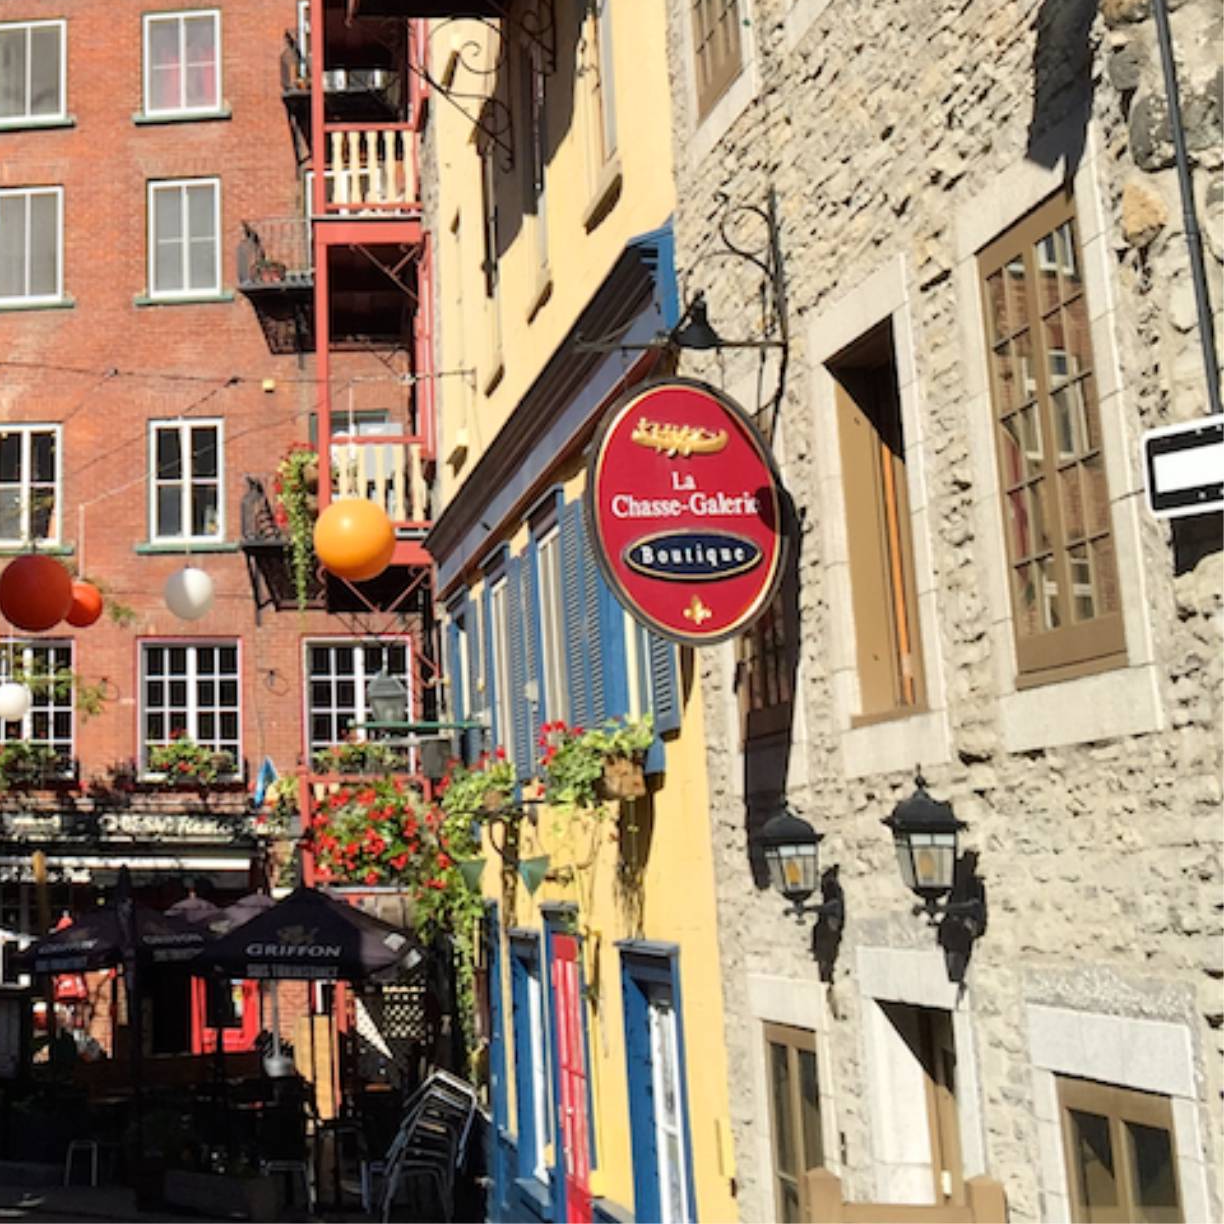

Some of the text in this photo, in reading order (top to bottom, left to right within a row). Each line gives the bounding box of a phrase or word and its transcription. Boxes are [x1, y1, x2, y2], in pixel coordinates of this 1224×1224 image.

[671, 471, 697, 490] La
[611, 491, 761, 518] Chasse-Galerie
[640, 542, 746, 568] Boutique
[246, 942, 342, 958] GRIFFON
